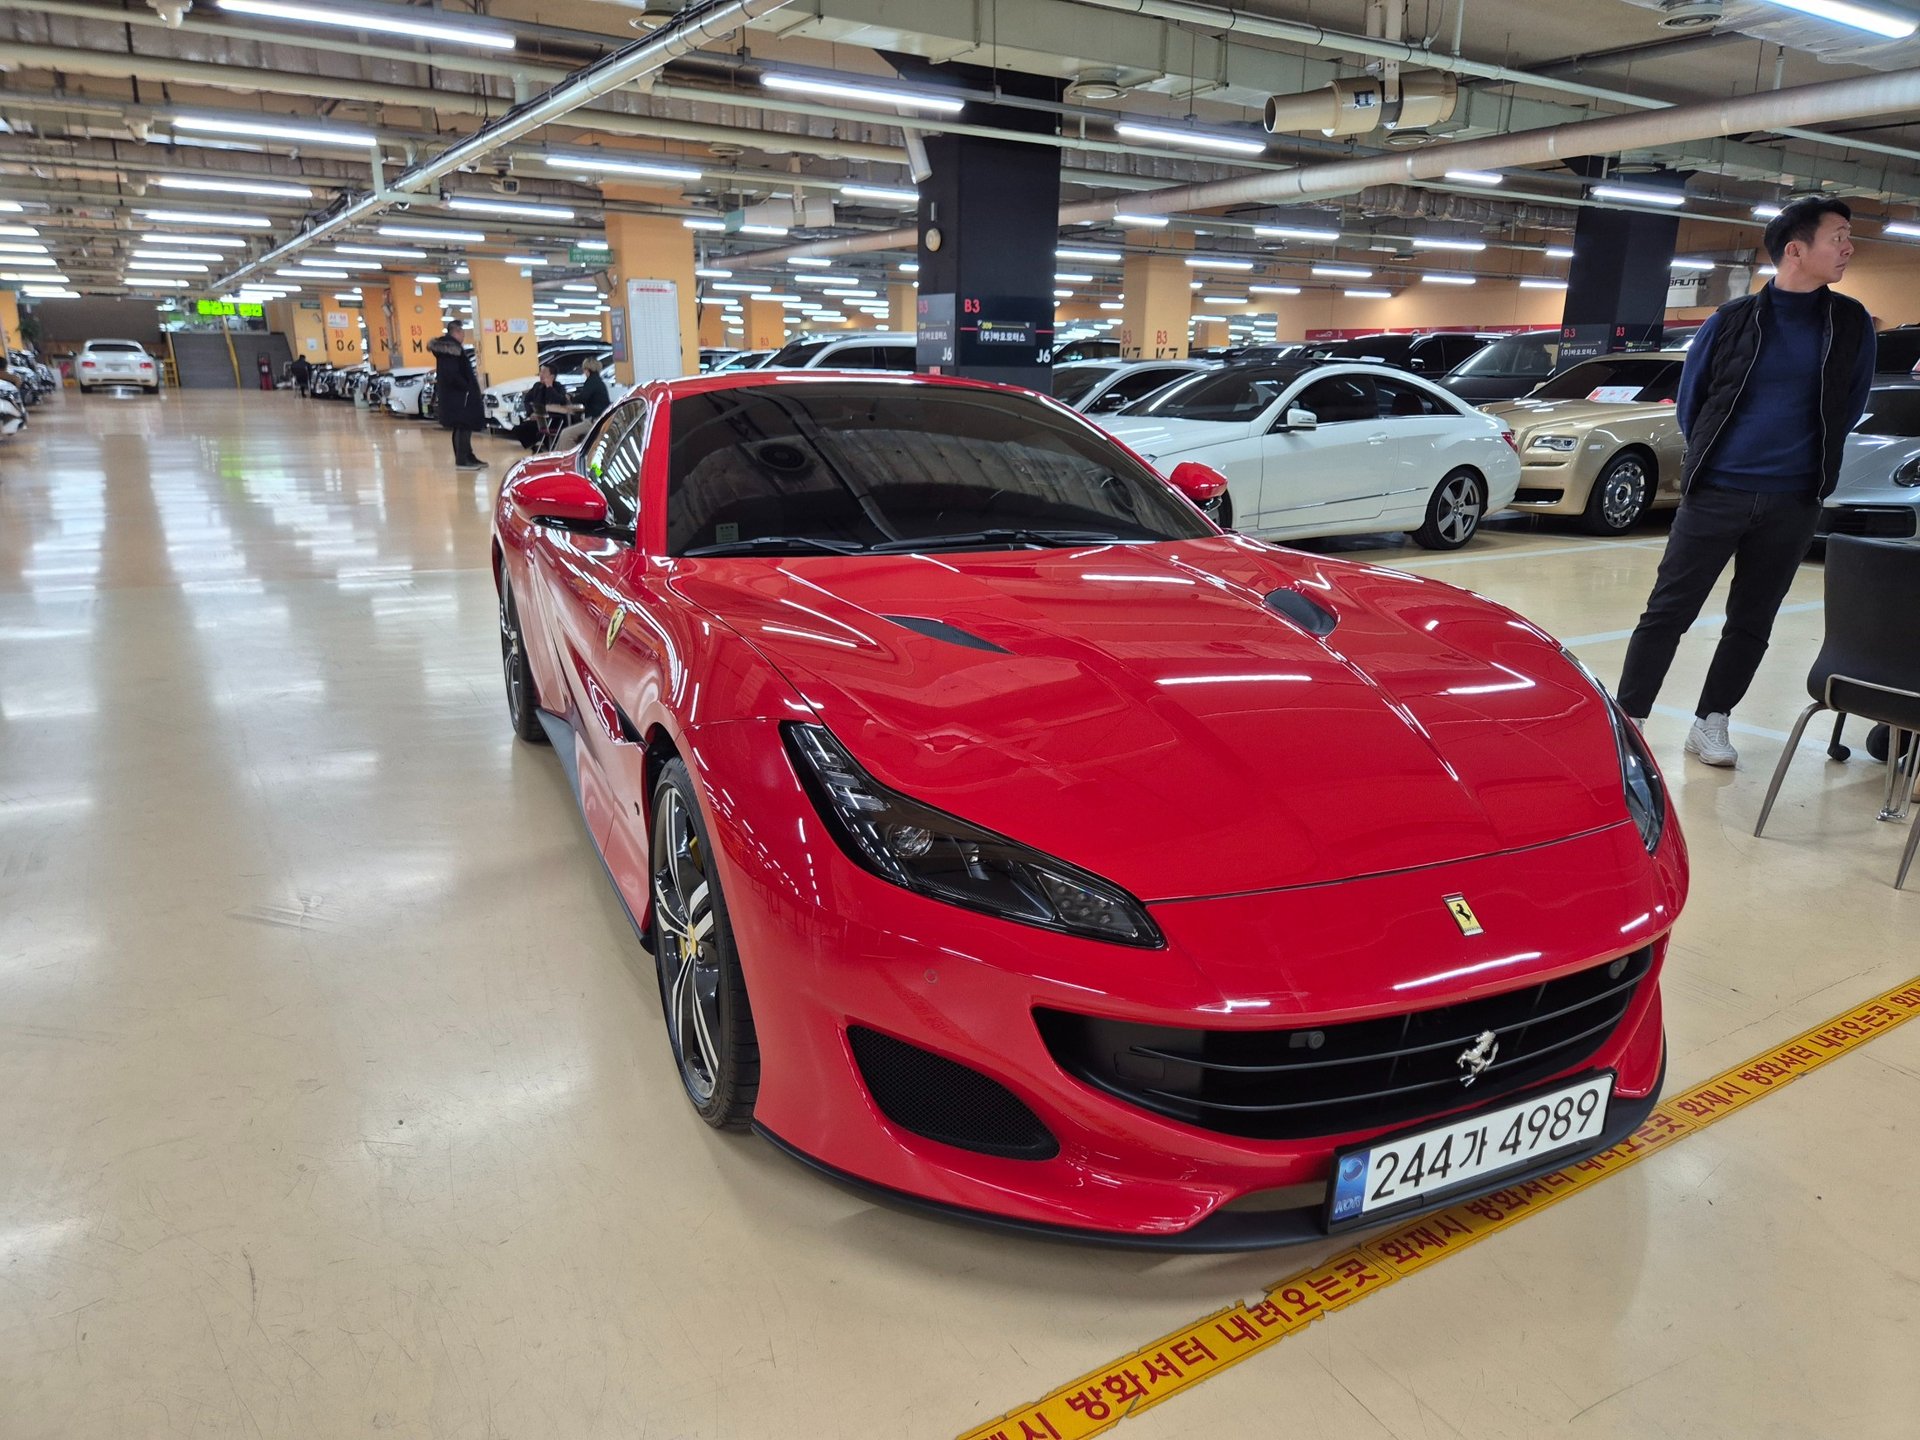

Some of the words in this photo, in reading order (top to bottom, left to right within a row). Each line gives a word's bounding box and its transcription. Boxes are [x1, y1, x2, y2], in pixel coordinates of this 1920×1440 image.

[964, 298, 980, 313] B3
[494, 319, 508, 333] B3
[1563, 327, 1576, 338] B3
[1616, 326, 1625, 337] B3
[1156, 330, 1168, 345] B3
[942, 347, 953, 361] J6
[1035, 348, 1051, 363] J6
[1677, 1081, 1751, 1117] 화재시
[1737, 1045, 1823, 1086] 방화셔터
[1808, 1005, 1902, 1048] 내려오는곳
[1371, 1126, 1488, 1202] 244가
[1498, 1088, 1600, 1156] 4989
[1378, 1214, 1473, 1265] 화재시
[1065, 1336, 1218, 1421] 방화셔터
[1215, 1257, 1379, 1343] 내려오는곳
